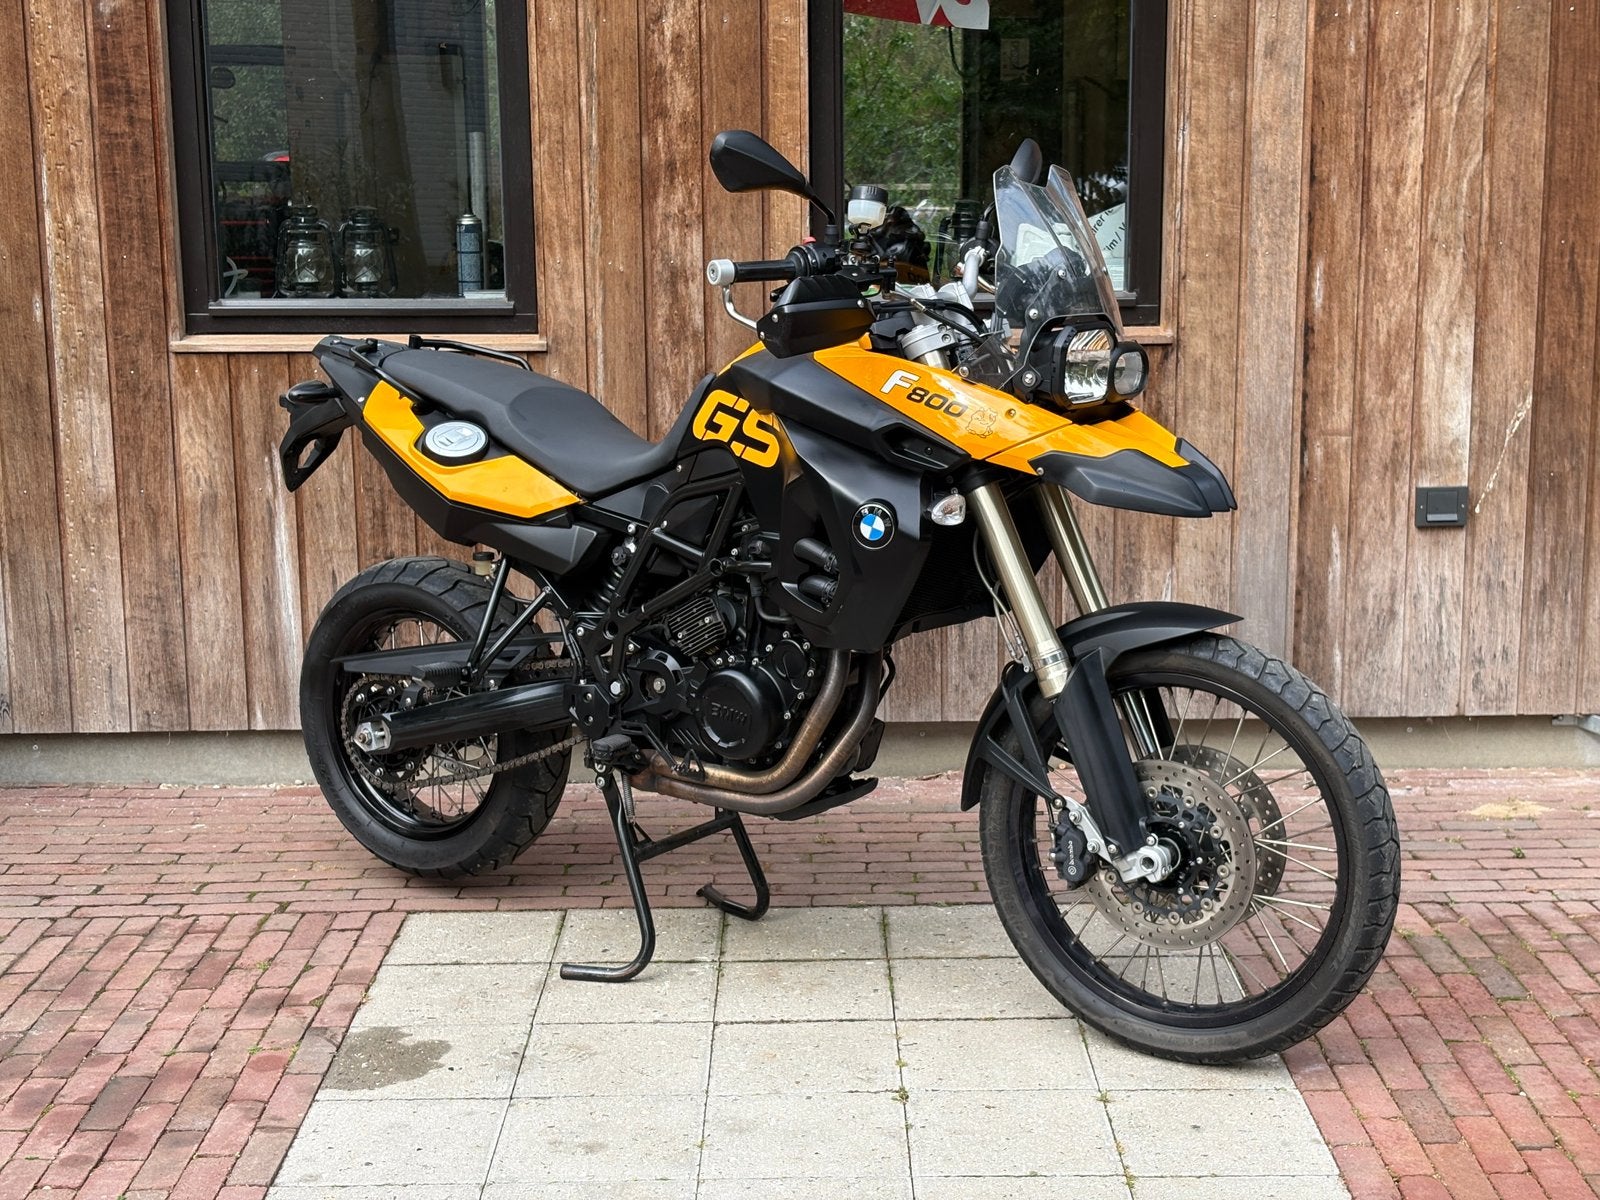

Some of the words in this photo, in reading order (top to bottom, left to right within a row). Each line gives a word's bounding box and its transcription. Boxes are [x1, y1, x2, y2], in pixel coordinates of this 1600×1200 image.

[692, 389, 780, 468] GS
[861, 507, 892, 527] BMW
[711, 702, 748, 726] BMW
